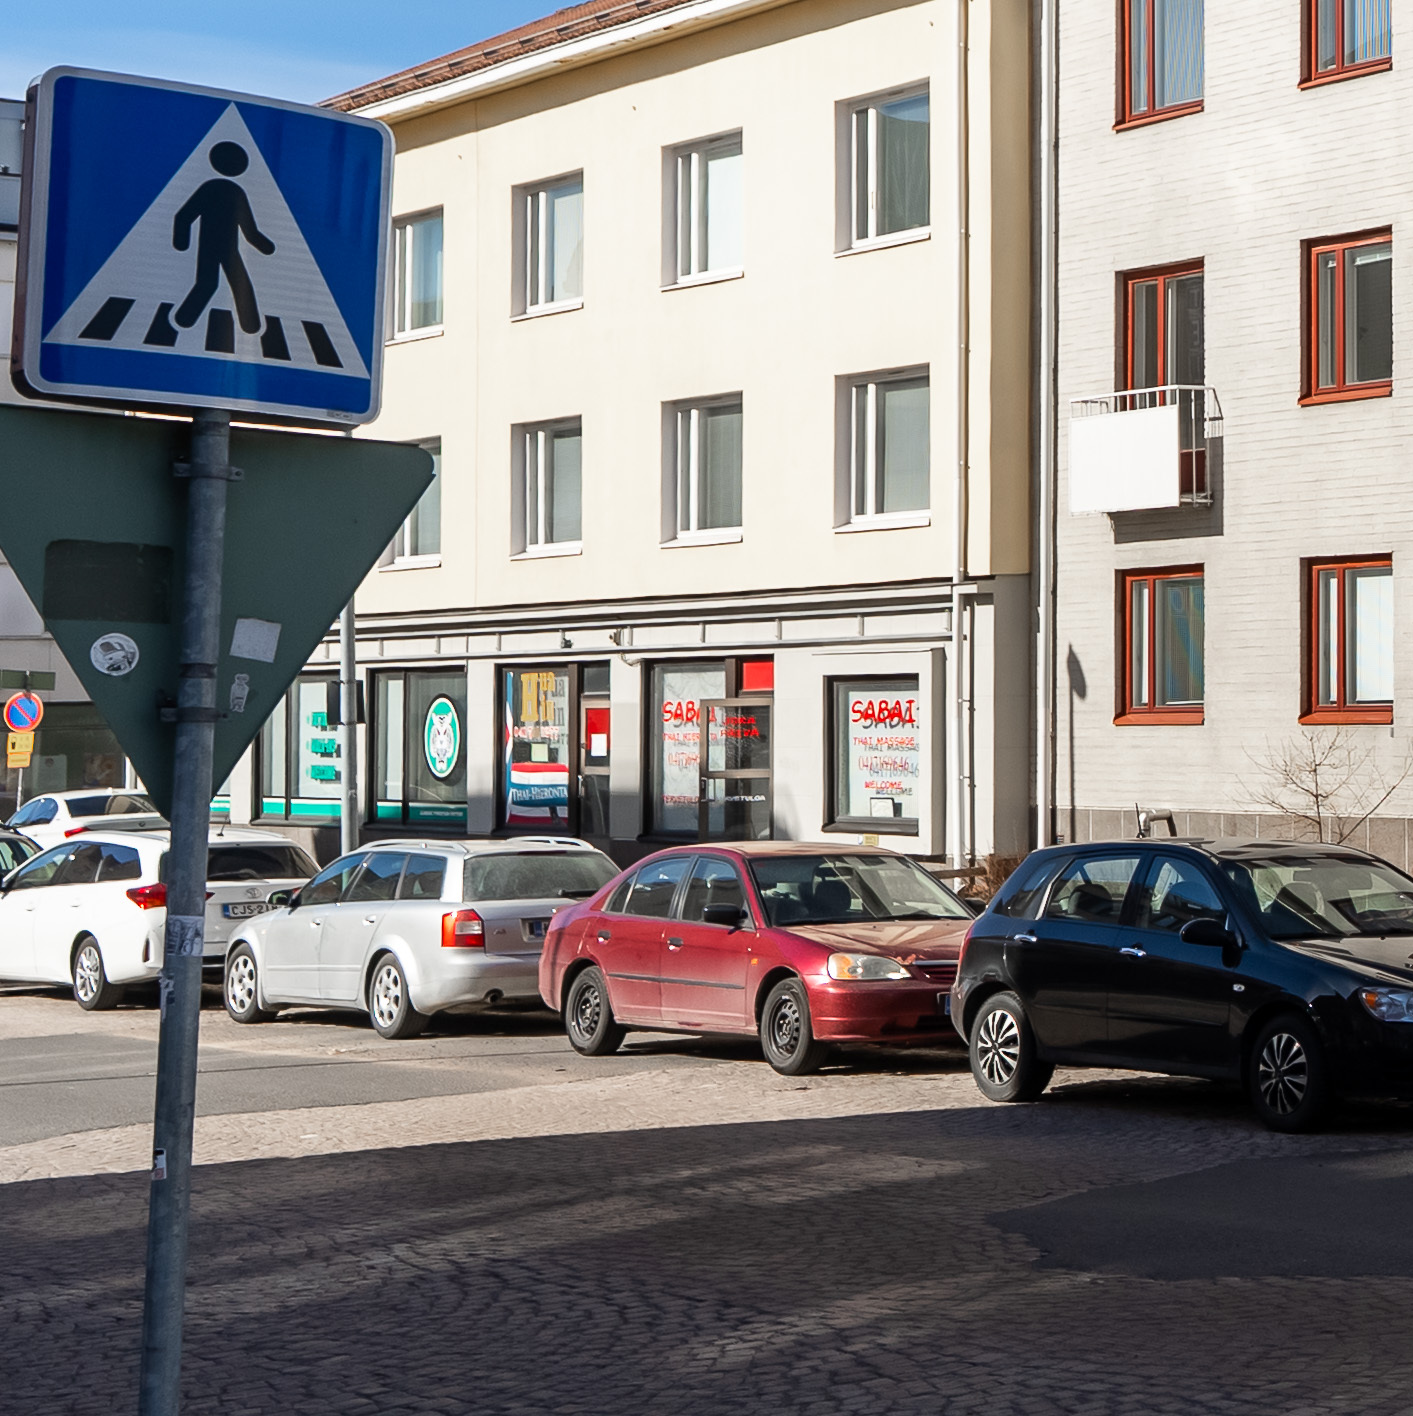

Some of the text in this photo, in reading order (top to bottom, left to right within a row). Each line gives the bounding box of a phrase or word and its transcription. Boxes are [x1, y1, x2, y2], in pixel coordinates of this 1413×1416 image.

[662, 701, 717, 722] SABI
[852, 700, 916, 723] SABAI
[853, 737, 872, 745] THAI
